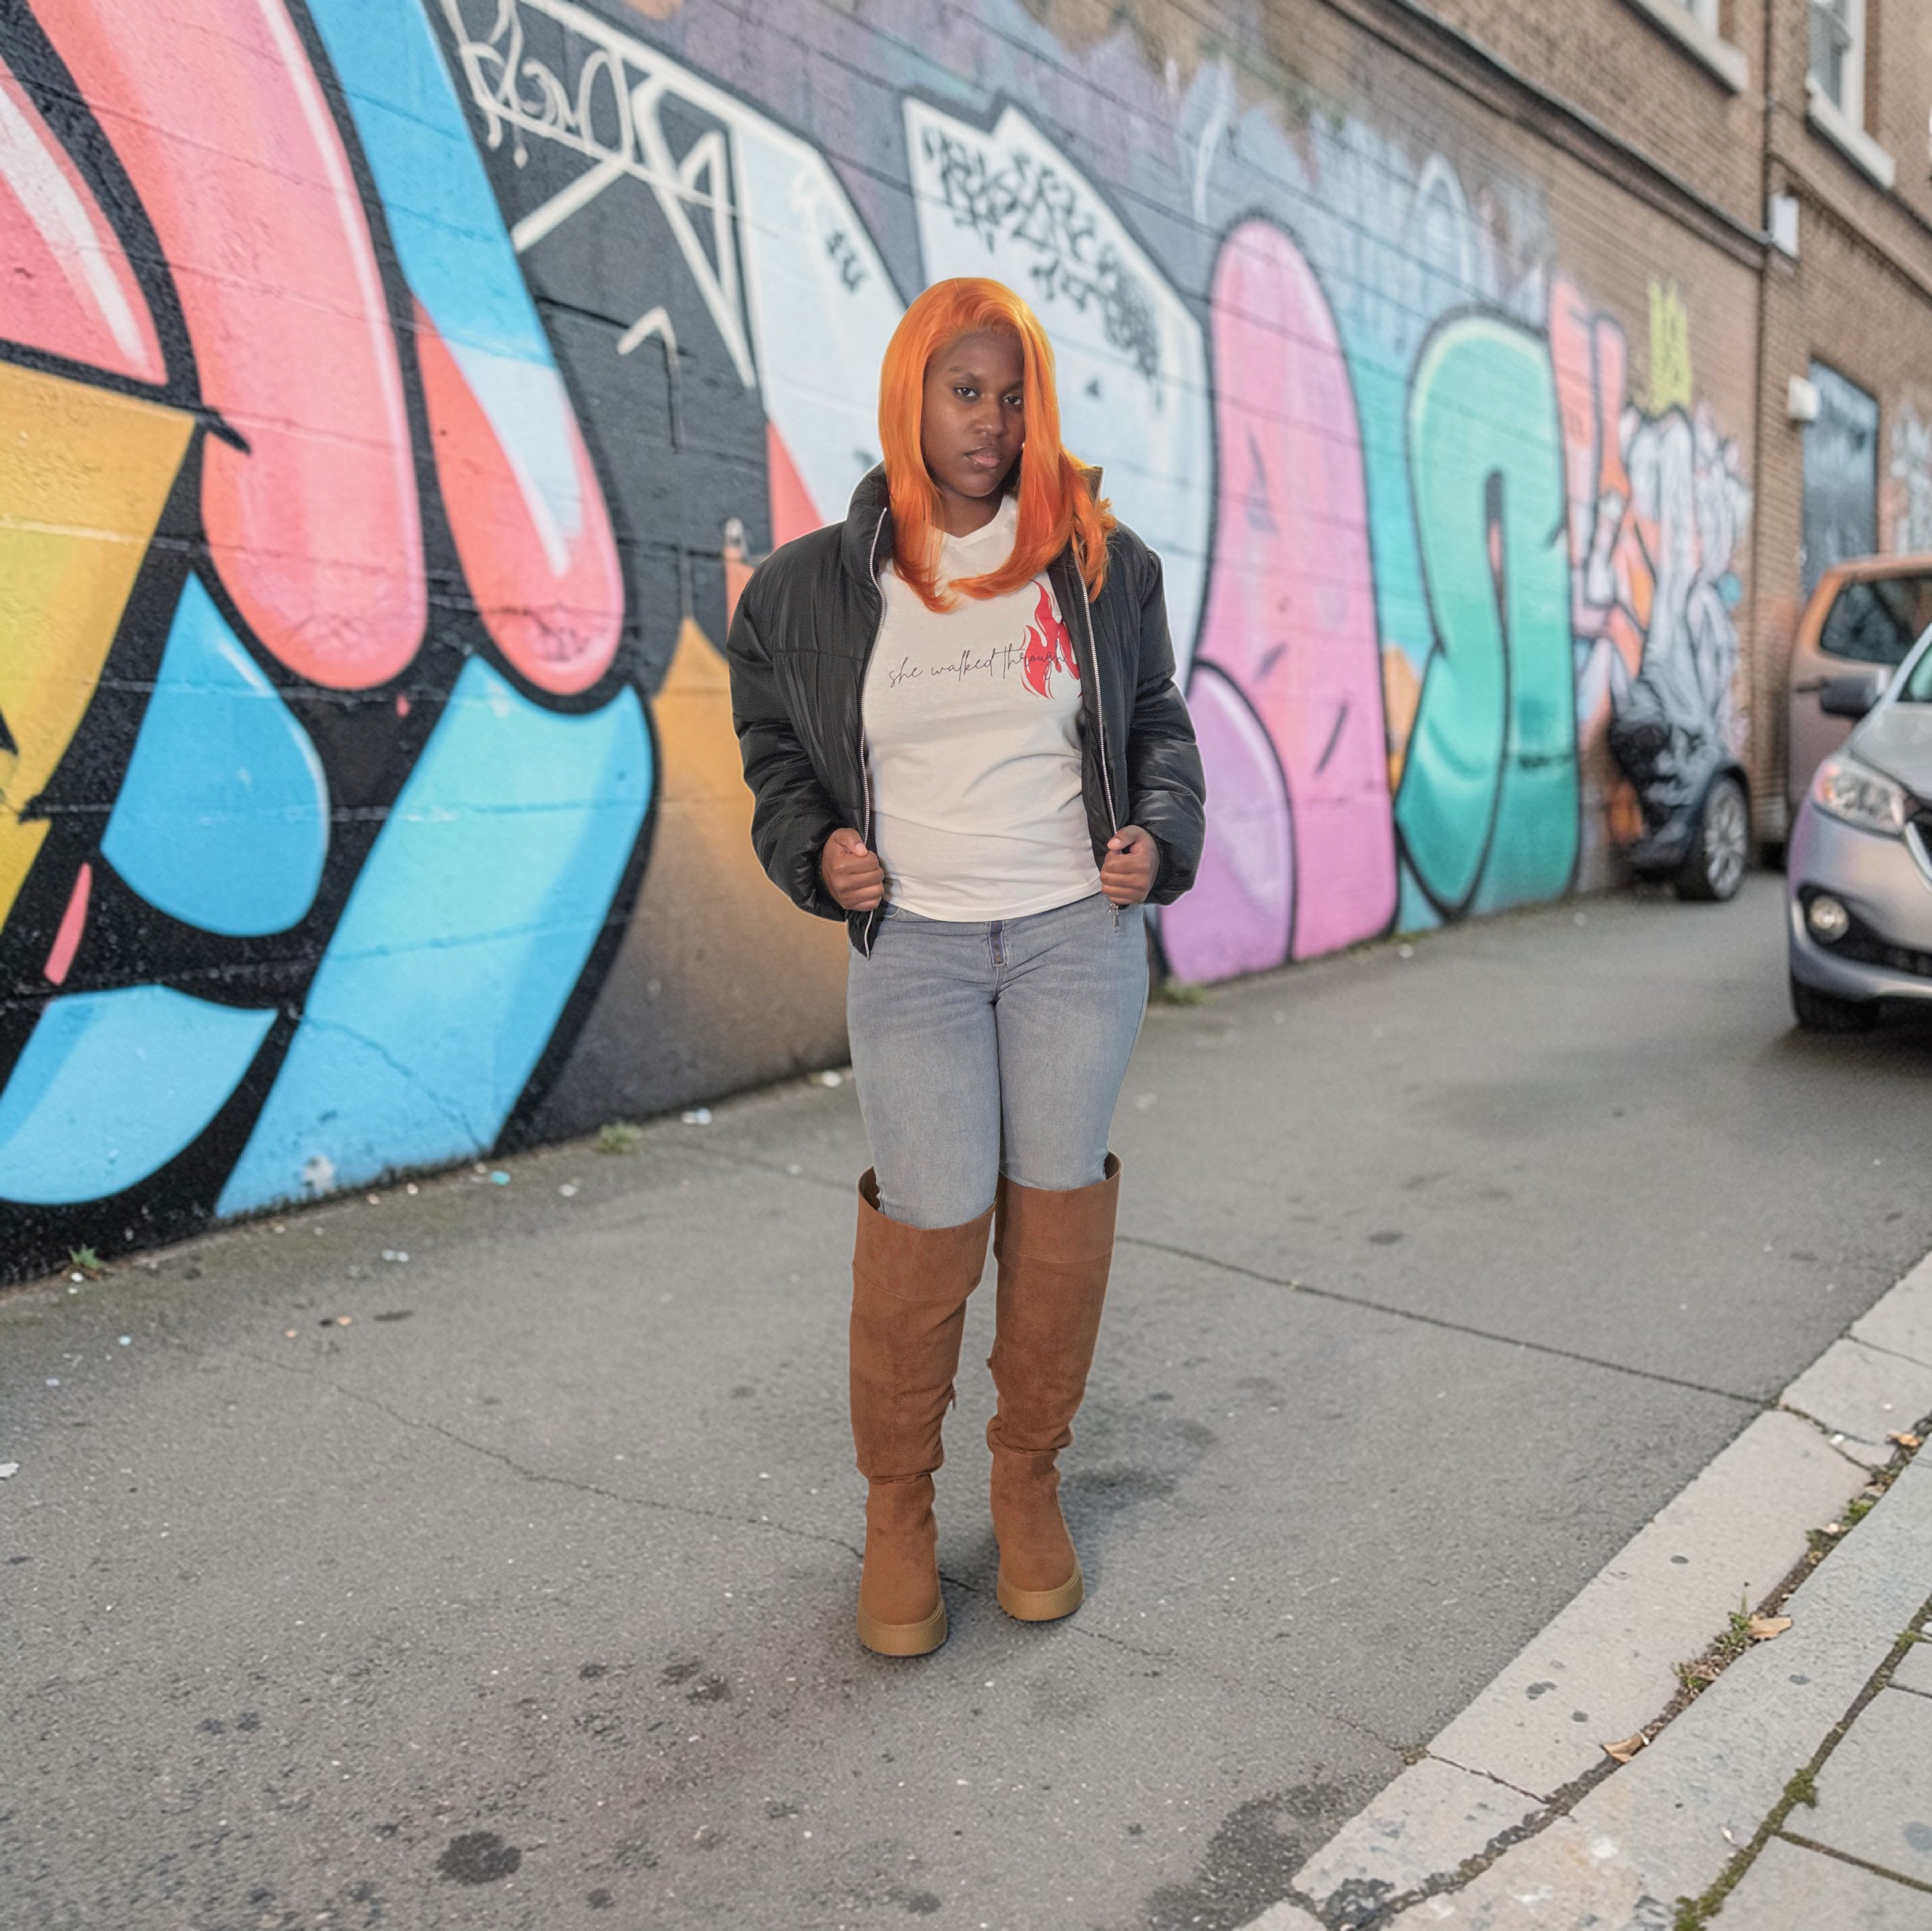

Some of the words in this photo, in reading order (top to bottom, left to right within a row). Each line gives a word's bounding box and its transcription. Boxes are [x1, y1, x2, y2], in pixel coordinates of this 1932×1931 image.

[888, 656, 923, 688] she
[931, 648, 995, 681] walked
[995, 639, 1066, 680] through
